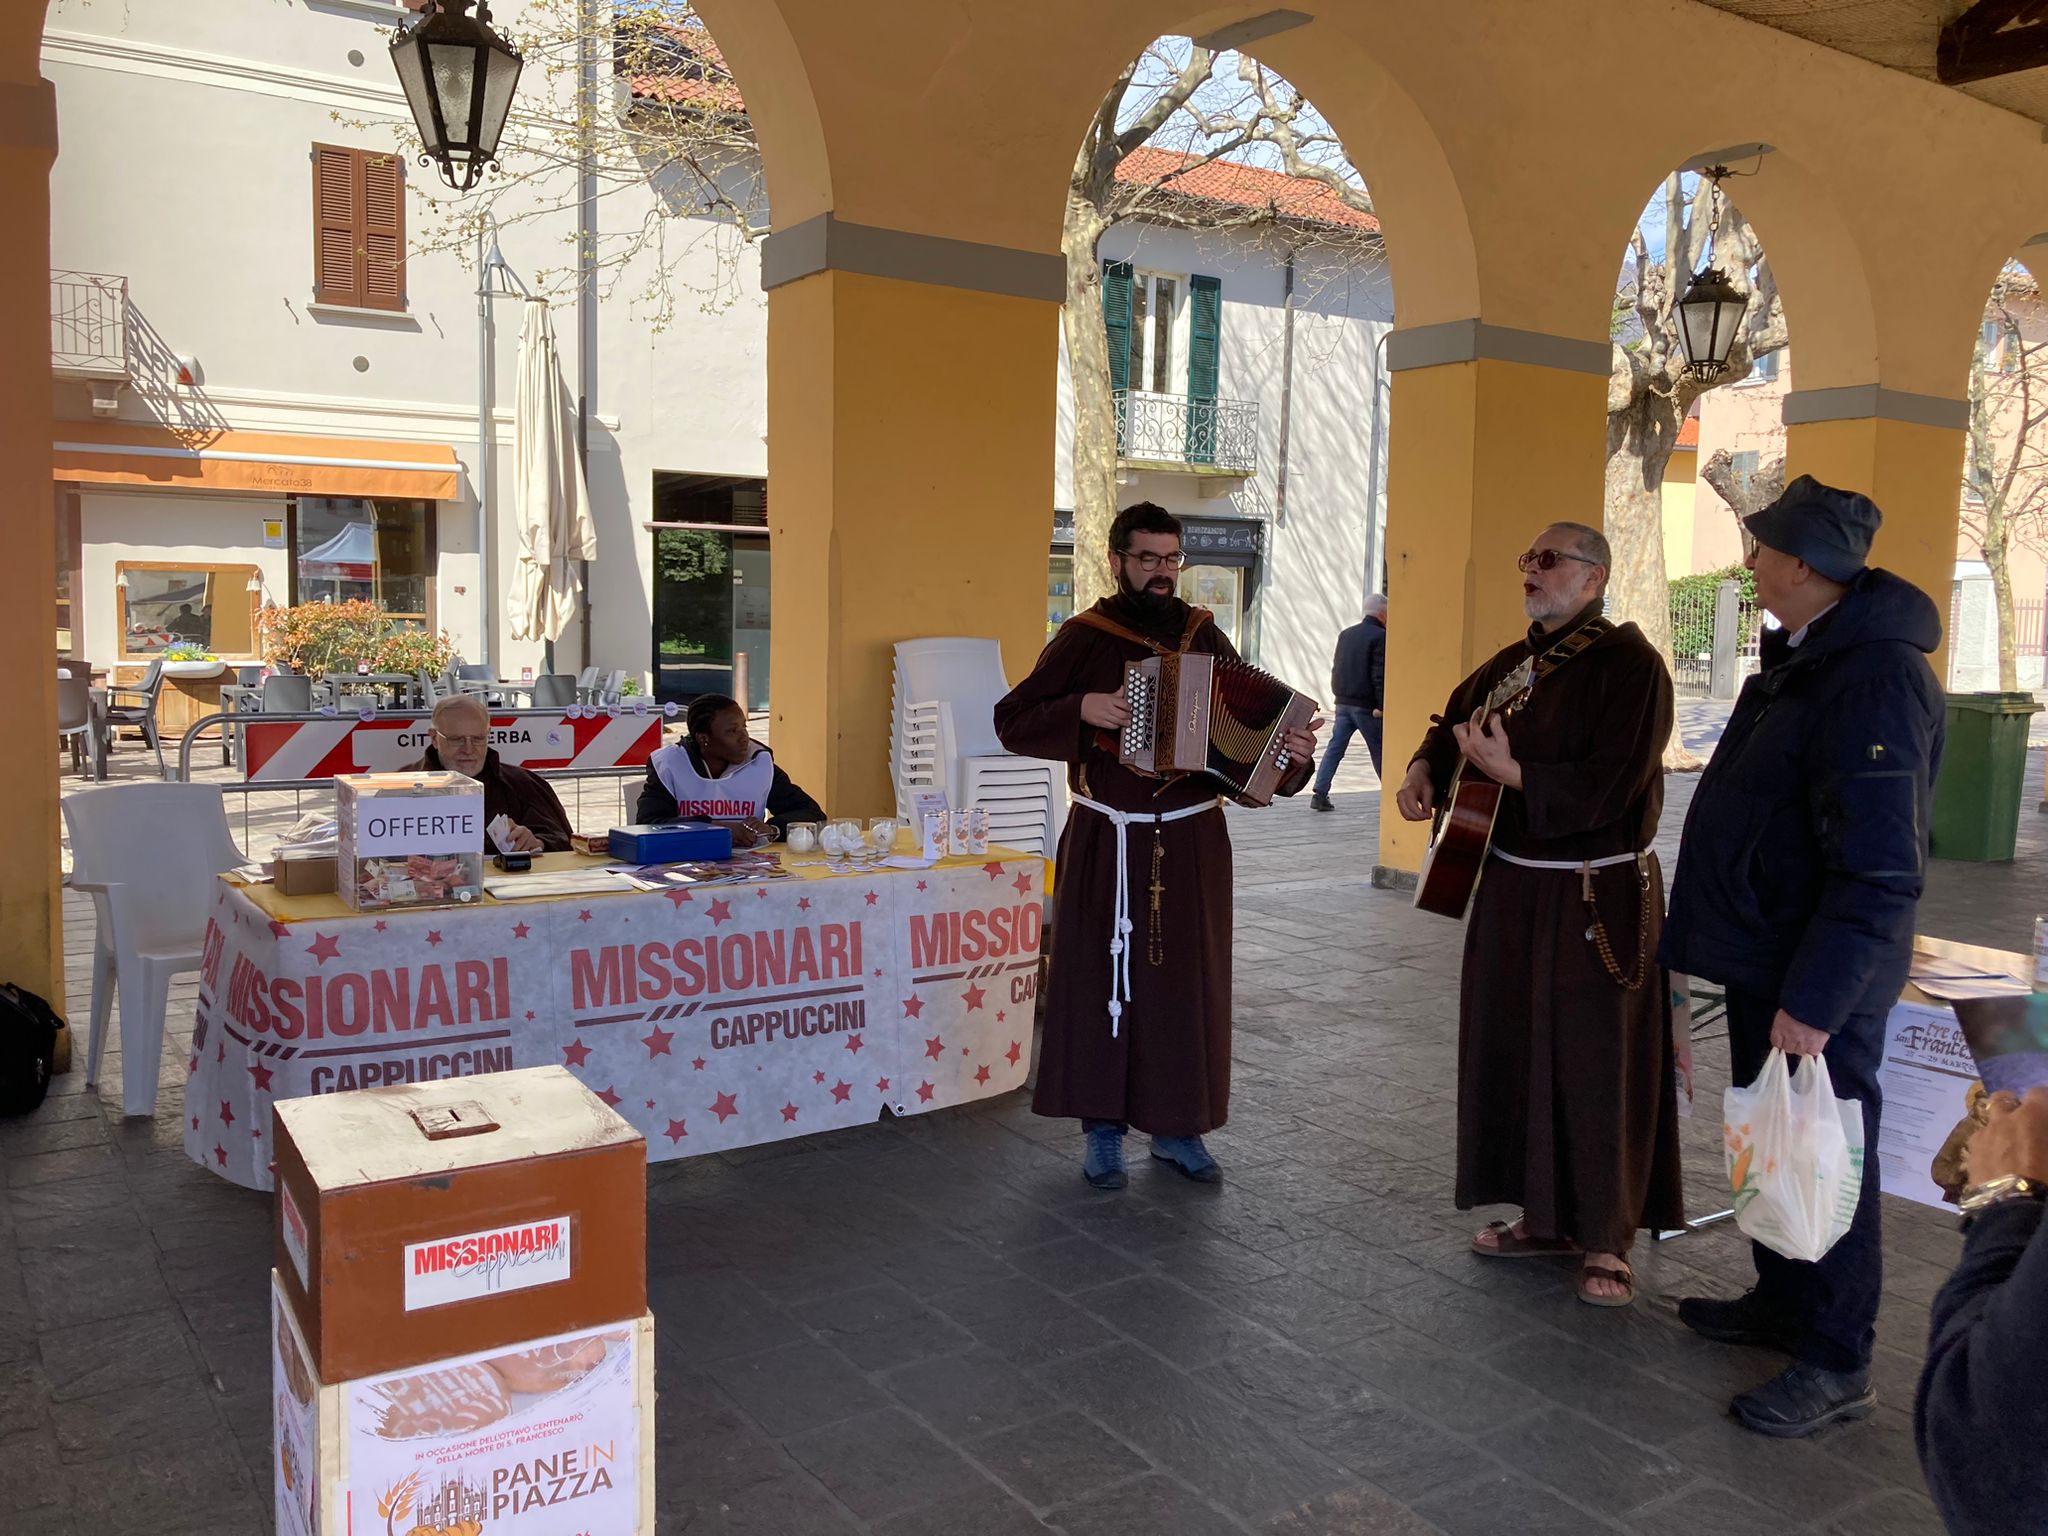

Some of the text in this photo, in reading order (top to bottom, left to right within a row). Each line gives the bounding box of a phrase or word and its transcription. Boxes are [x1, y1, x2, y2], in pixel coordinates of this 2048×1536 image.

[252, 476, 313, 487] Mercato38
[397, 730, 532, 747] CIT ERBA
[368, 814, 473, 838] OFFERTE
[678, 800, 756, 816] MISSIONARI
[909, 901, 1043, 969] MISSIO
[570, 920, 862, 1010] MISSIONARI
[226, 957, 512, 1041] MISSIONARI
[710, 999, 866, 1050] CAPPUCCINI
[310, 1046, 514, 1097] CAPPUCCINI
[414, 1223, 559, 1276] MISSIONARI
[415, 1412, 584, 1461] IN OCCASIONE DELL'OTTAVO CENTENARIO
[436, 1426, 565, 1465] DELLA MORTE DI S. FRANCESCO
[493, 1439, 615, 1494] PANE IN
[493, 1466, 613, 1520] PIAZZA
